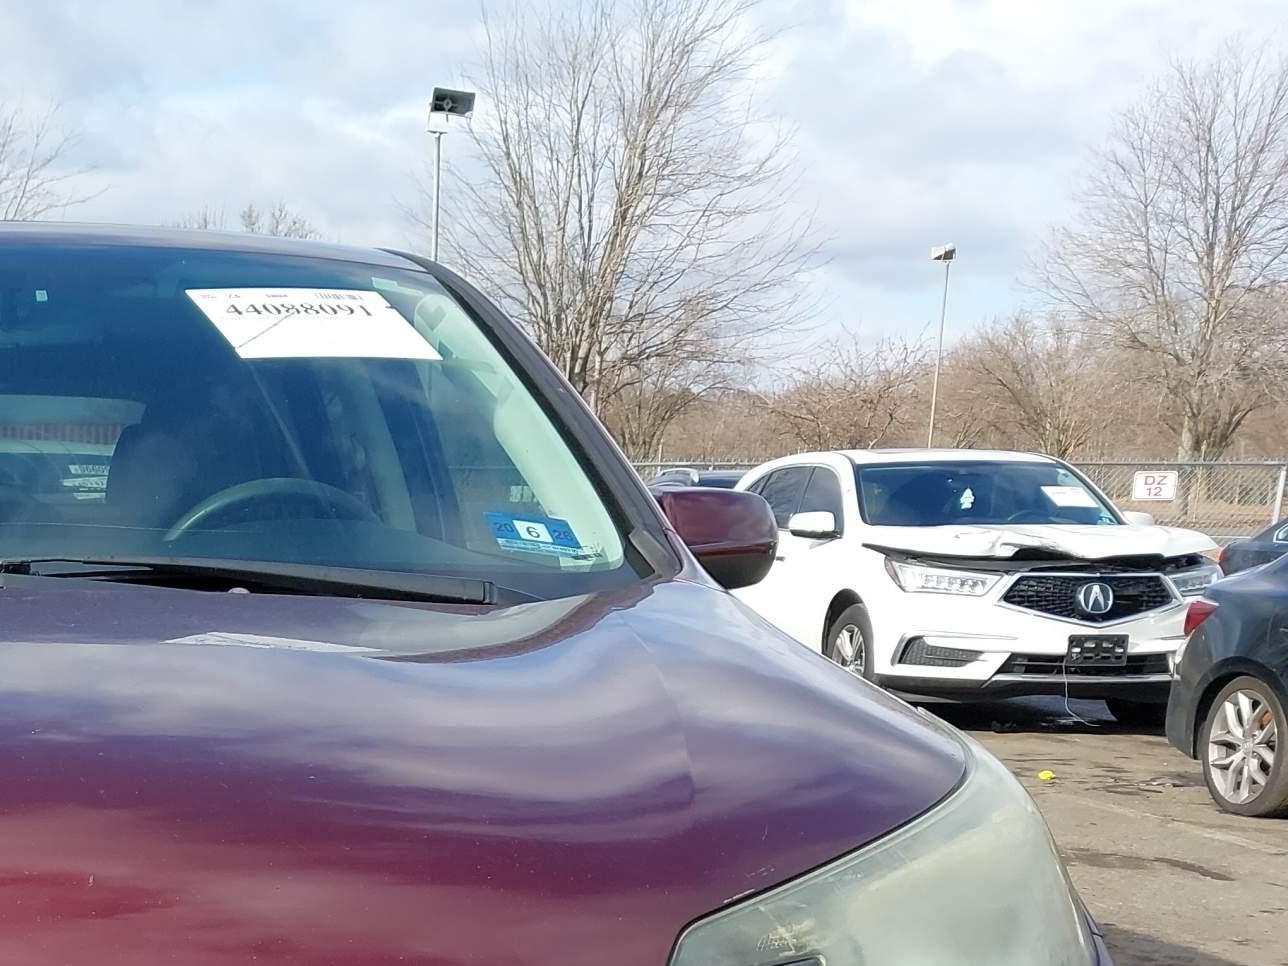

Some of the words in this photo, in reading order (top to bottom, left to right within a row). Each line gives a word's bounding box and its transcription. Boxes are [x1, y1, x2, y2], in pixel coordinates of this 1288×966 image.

[225, 302, 373, 317] 44088091
[1144, 475, 1168, 486] DZ
[1146, 486, 1162, 497] 12
[526, 526, 541, 539] 6
